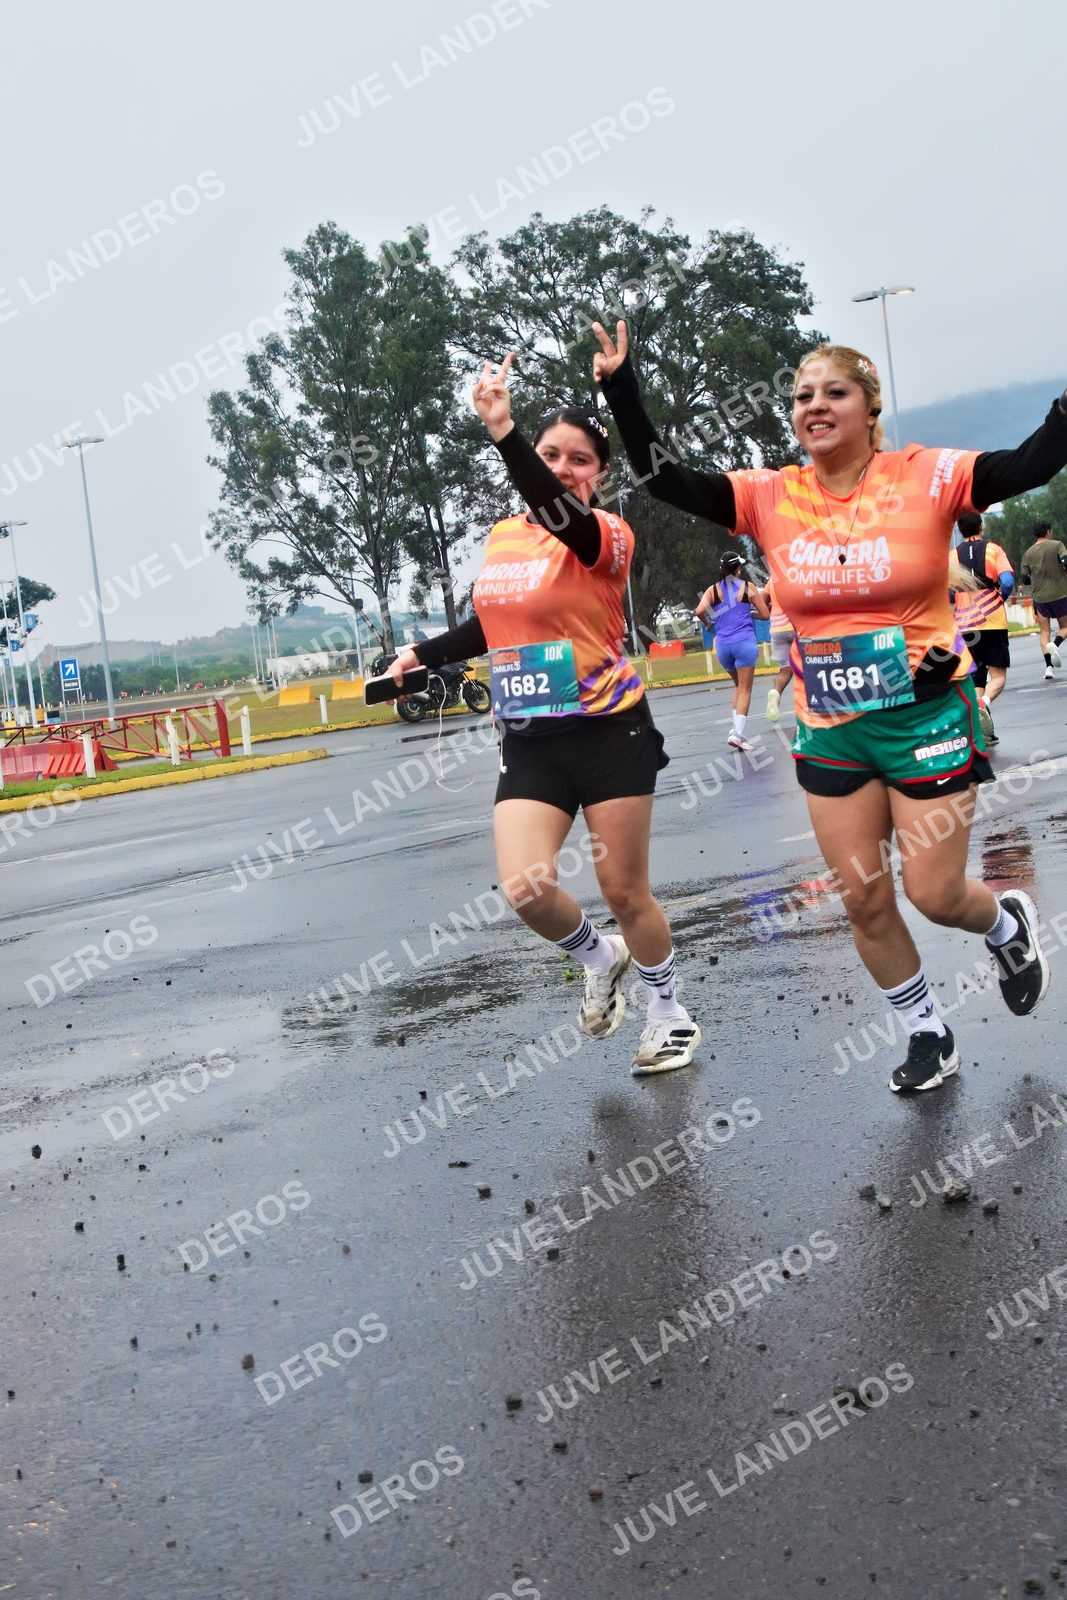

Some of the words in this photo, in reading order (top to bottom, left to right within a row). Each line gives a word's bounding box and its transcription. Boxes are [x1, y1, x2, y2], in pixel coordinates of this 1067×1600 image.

[788, 535, 891, 567] CARRERA
[544, 645, 564, 662] 10K
[872, 631, 895, 651] 10K
[500, 672, 550, 698] 1682
[816, 664, 880, 692] 1681
[914, 736, 968, 761] MEXICO
